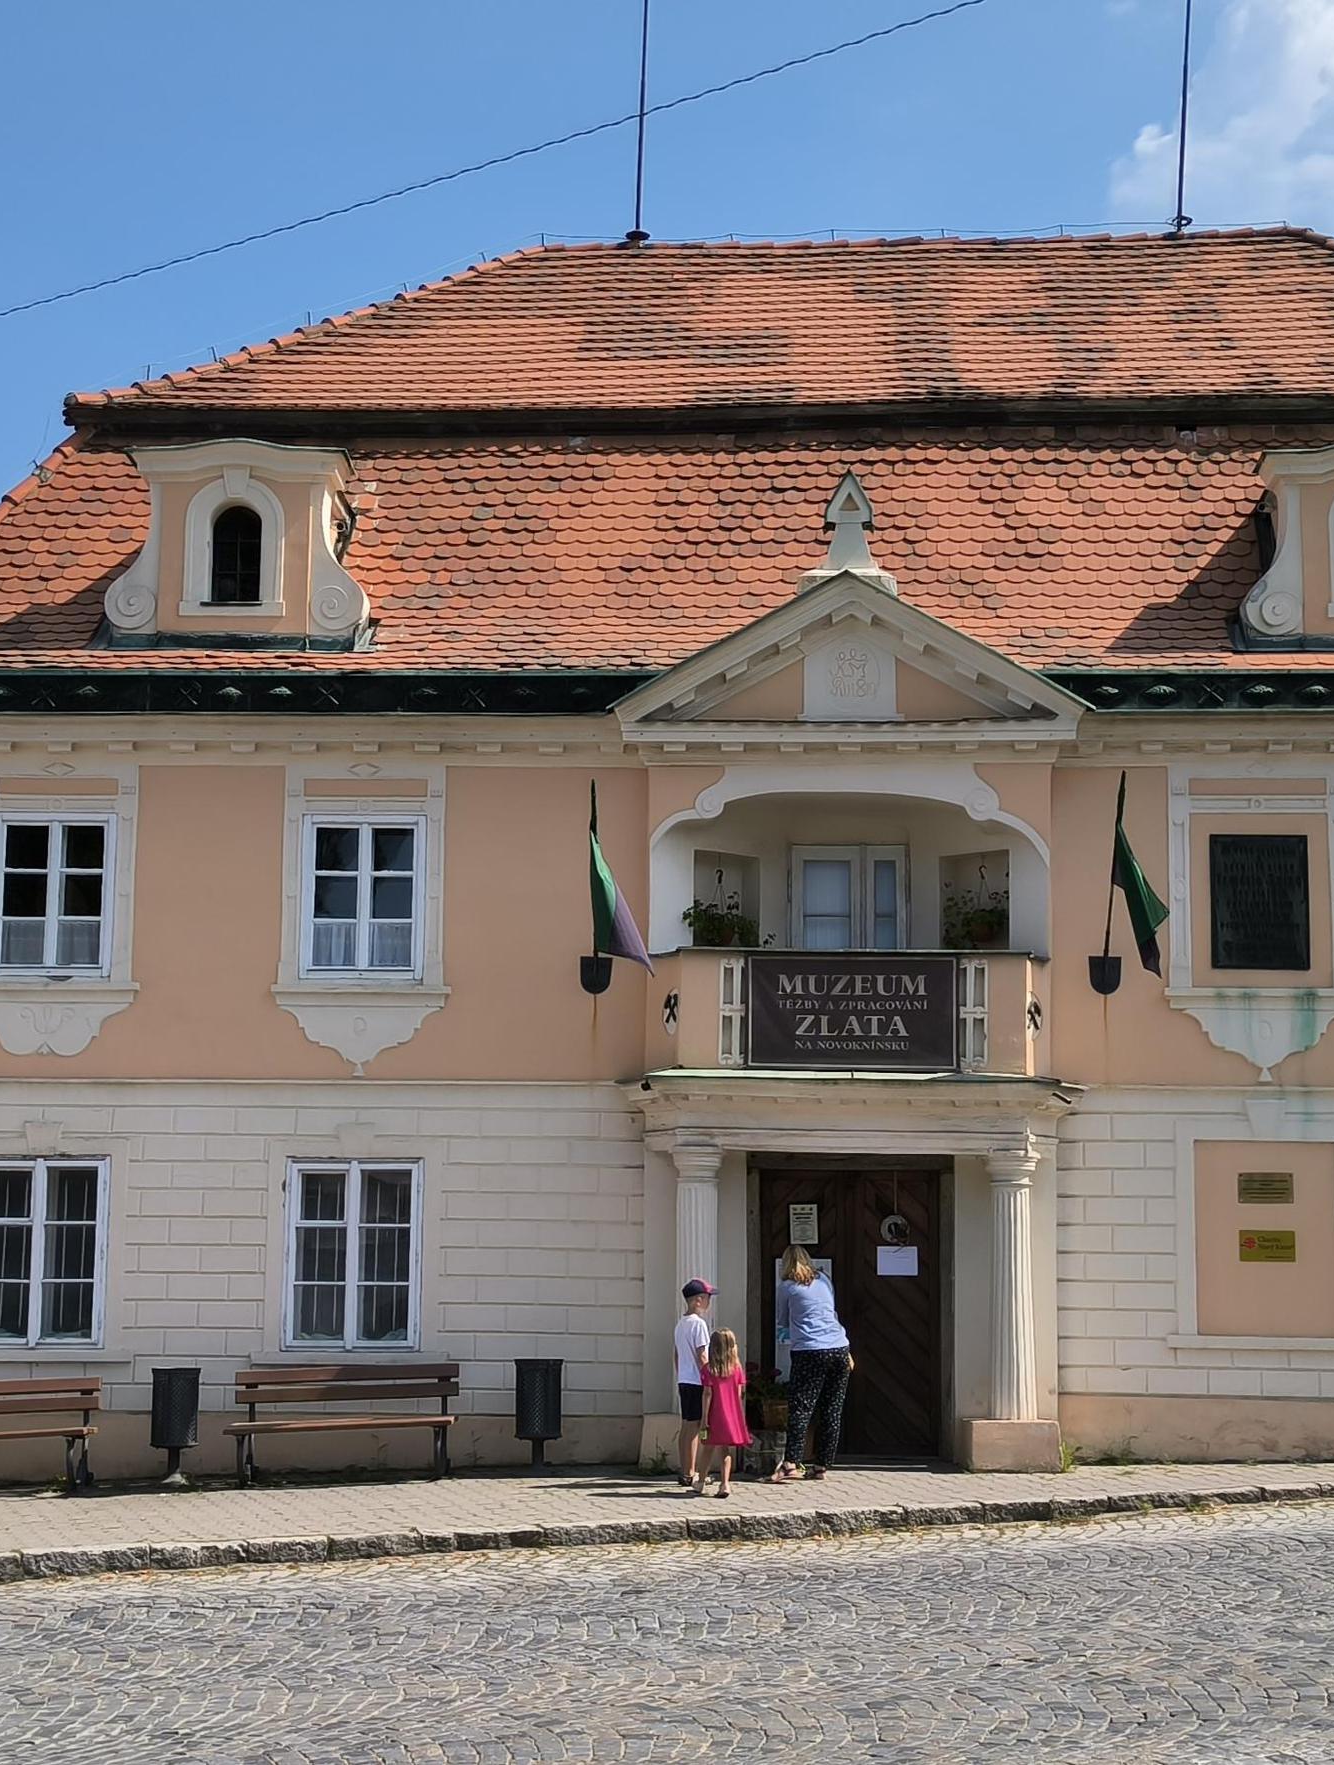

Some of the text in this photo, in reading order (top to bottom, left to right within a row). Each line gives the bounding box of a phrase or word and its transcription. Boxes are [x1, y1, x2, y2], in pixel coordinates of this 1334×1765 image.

[776, 973, 929, 996] MUZEUM
[777, 998, 929, 1011] TĚŽBY A ZPRACOVÁNÍ
[794, 1014, 910, 1037] ZLATA
[794, 1038, 910, 1051] NA NOVOKNÍNSKU
